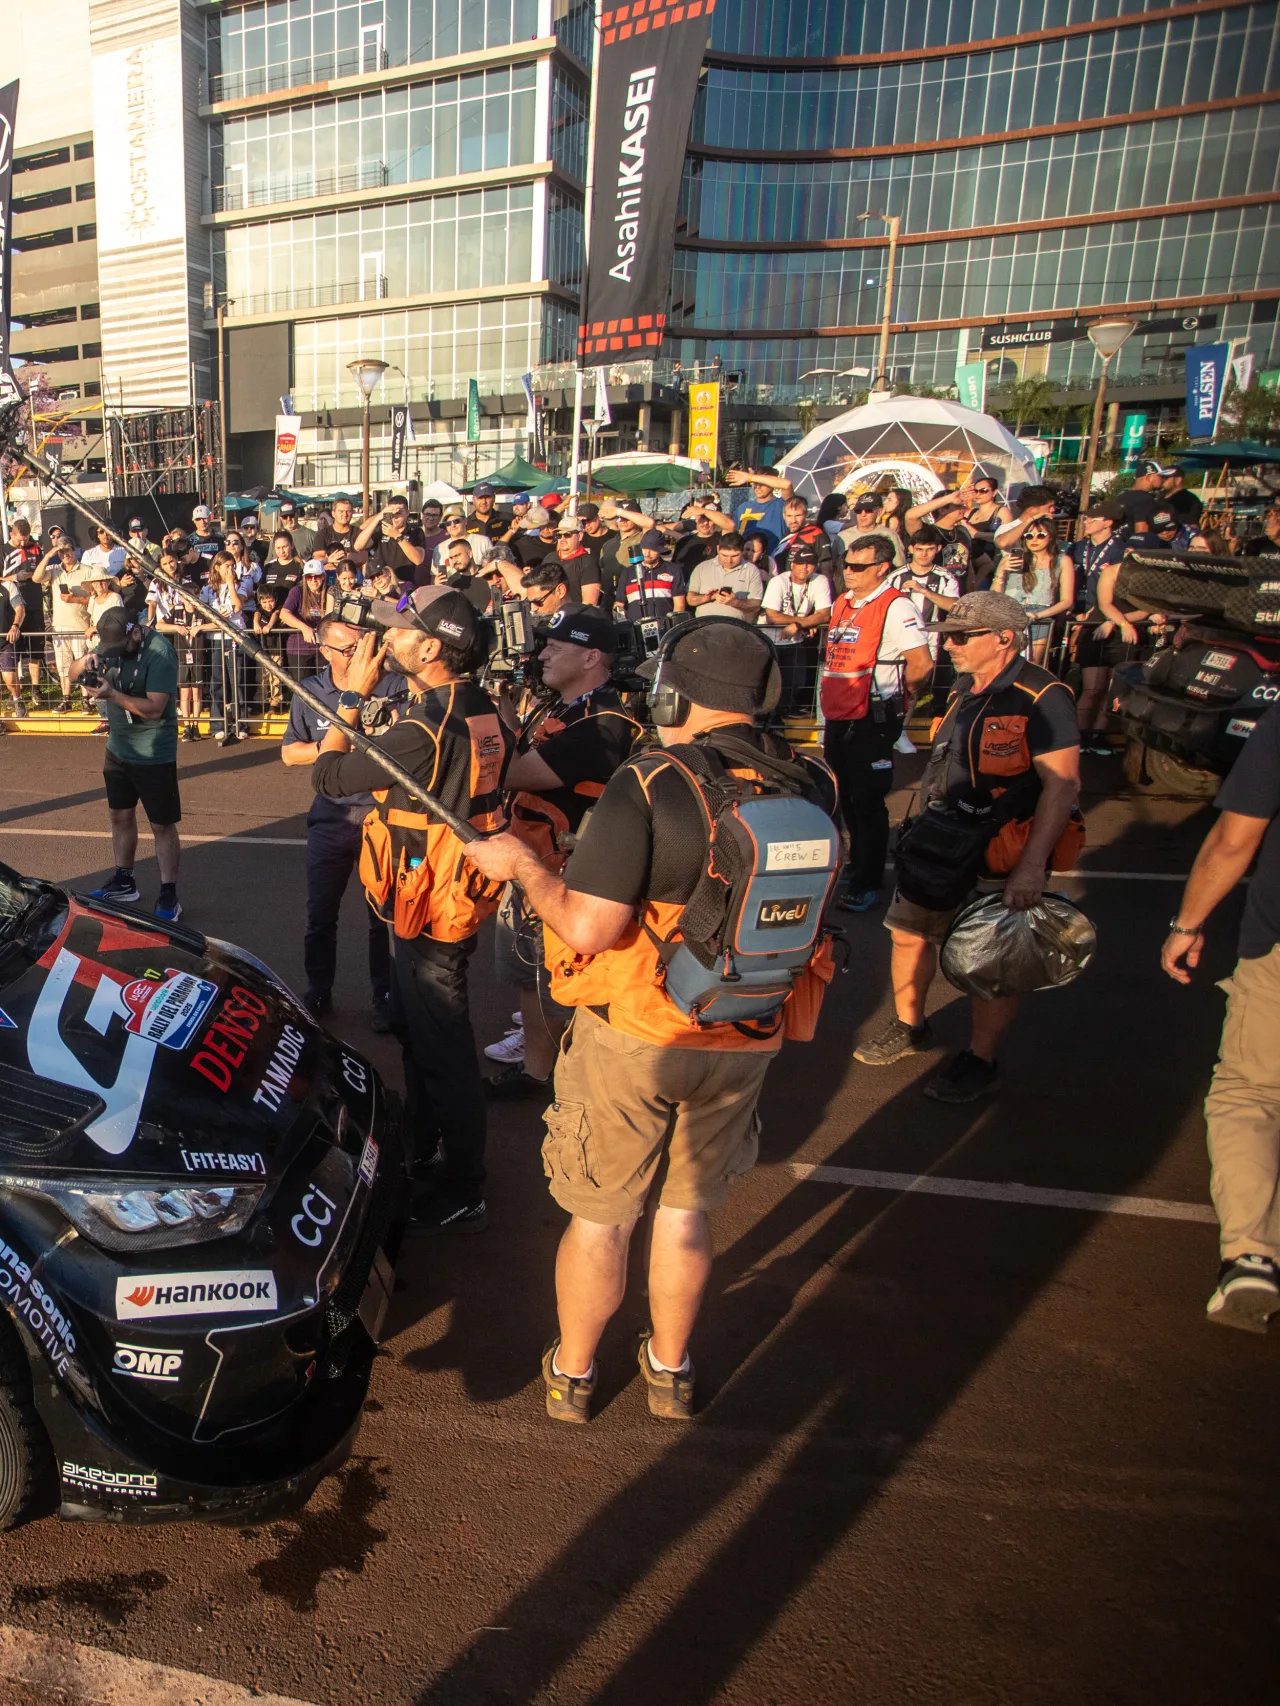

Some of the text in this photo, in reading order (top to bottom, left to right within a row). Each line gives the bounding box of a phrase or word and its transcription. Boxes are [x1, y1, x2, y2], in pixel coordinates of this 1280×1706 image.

[608, 65, 658, 283] AsahiKASEI
[989, 331, 1053, 345] SUSHICLUB
[1198, 361, 1216, 420] PILSEN
[774, 848, 822, 862] CREW E
[143, 968, 162, 980] 17
[147, 975, 198, 1040] RALLY DEL PARAGUAY
[180, 1002, 193, 1017] 2025
[189, 985, 267, 1093] DENSO
[253, 1023, 306, 1114] TAMADIC
[113, 1350, 183, 1377] OMP
[62, 1461, 157, 1486] akebono
[62, 1476, 157, 1497] BRAKE EXPERTS
